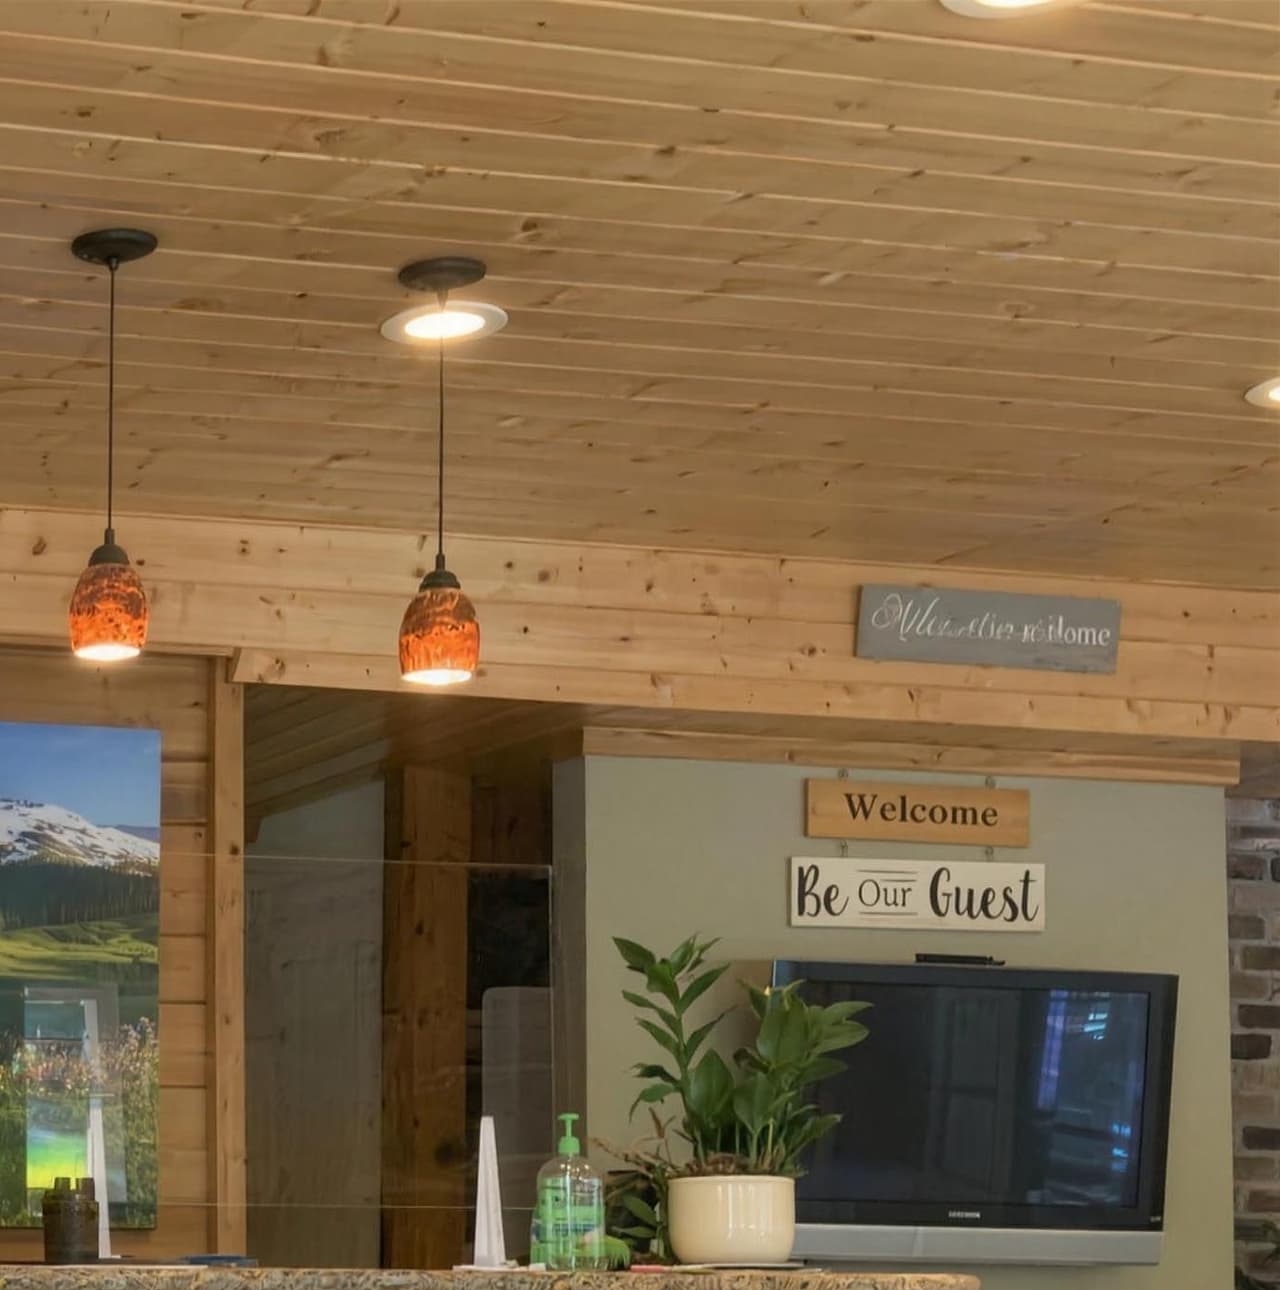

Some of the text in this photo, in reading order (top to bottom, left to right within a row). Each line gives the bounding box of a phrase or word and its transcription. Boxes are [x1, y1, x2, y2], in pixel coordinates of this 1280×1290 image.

[843, 793, 999, 827] Welcome
[797, 864, 1040, 922] Be Our Guest
